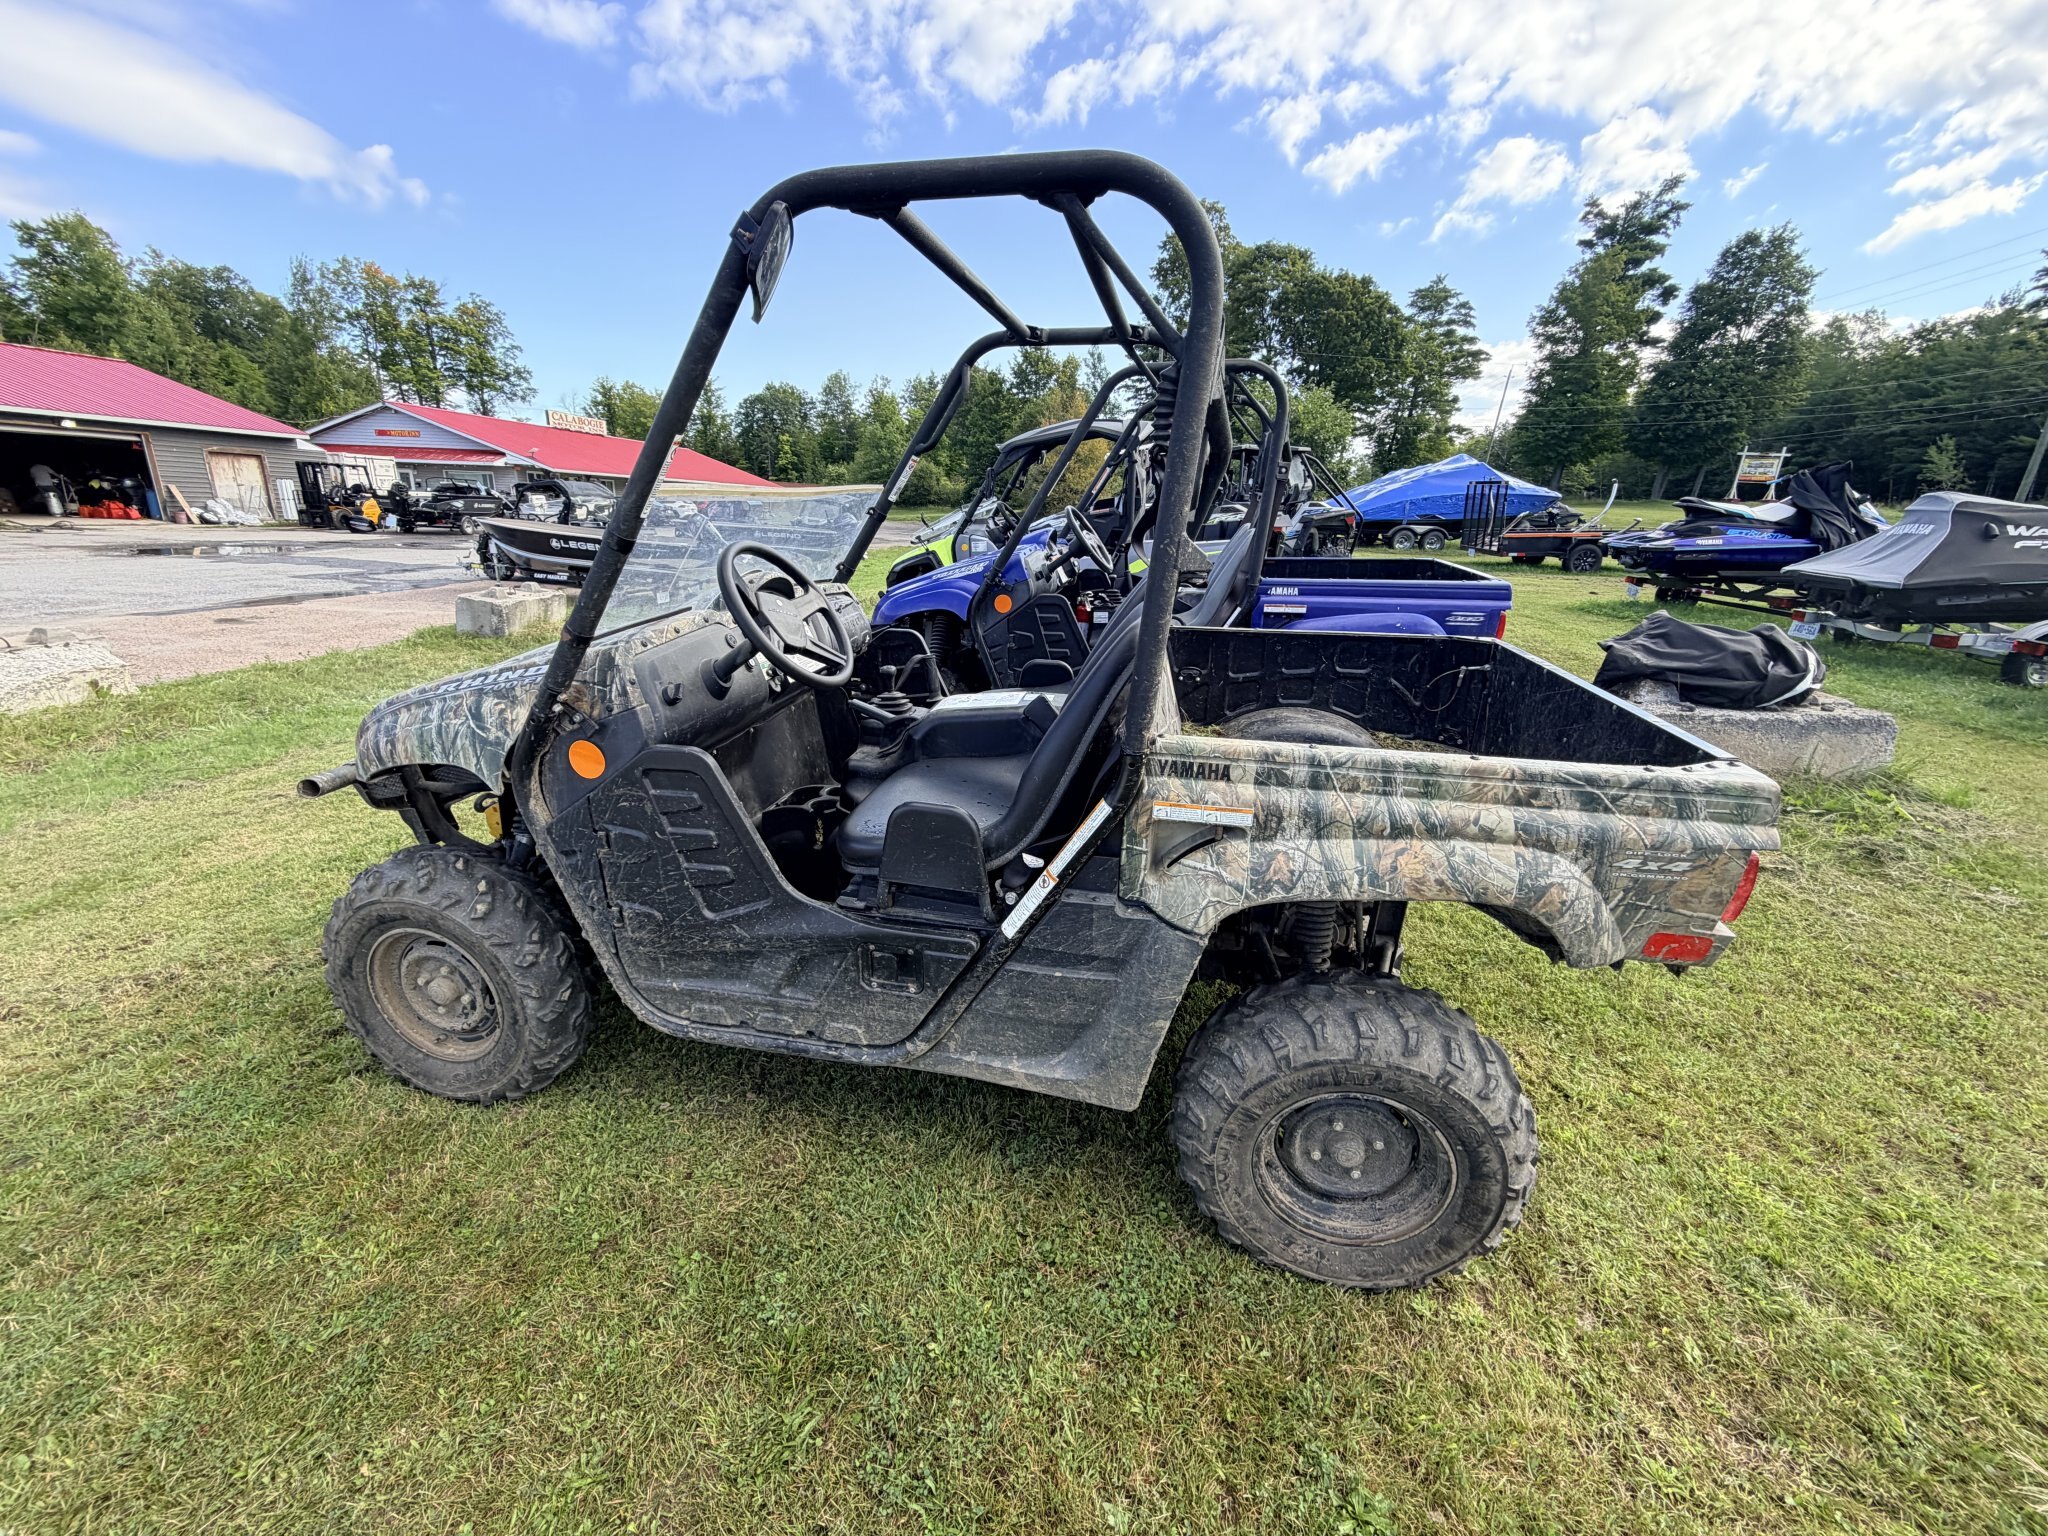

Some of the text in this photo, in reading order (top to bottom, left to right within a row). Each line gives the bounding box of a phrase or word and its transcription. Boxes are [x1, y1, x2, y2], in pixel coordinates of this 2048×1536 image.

[551, 411, 604, 429] CALABOGIE
[761, 531, 801, 539] LEGEND
[560, 540, 601, 551] LEGEN
[483, 680, 518, 693] 700
[1159, 759, 1232, 781] YAMAHA
